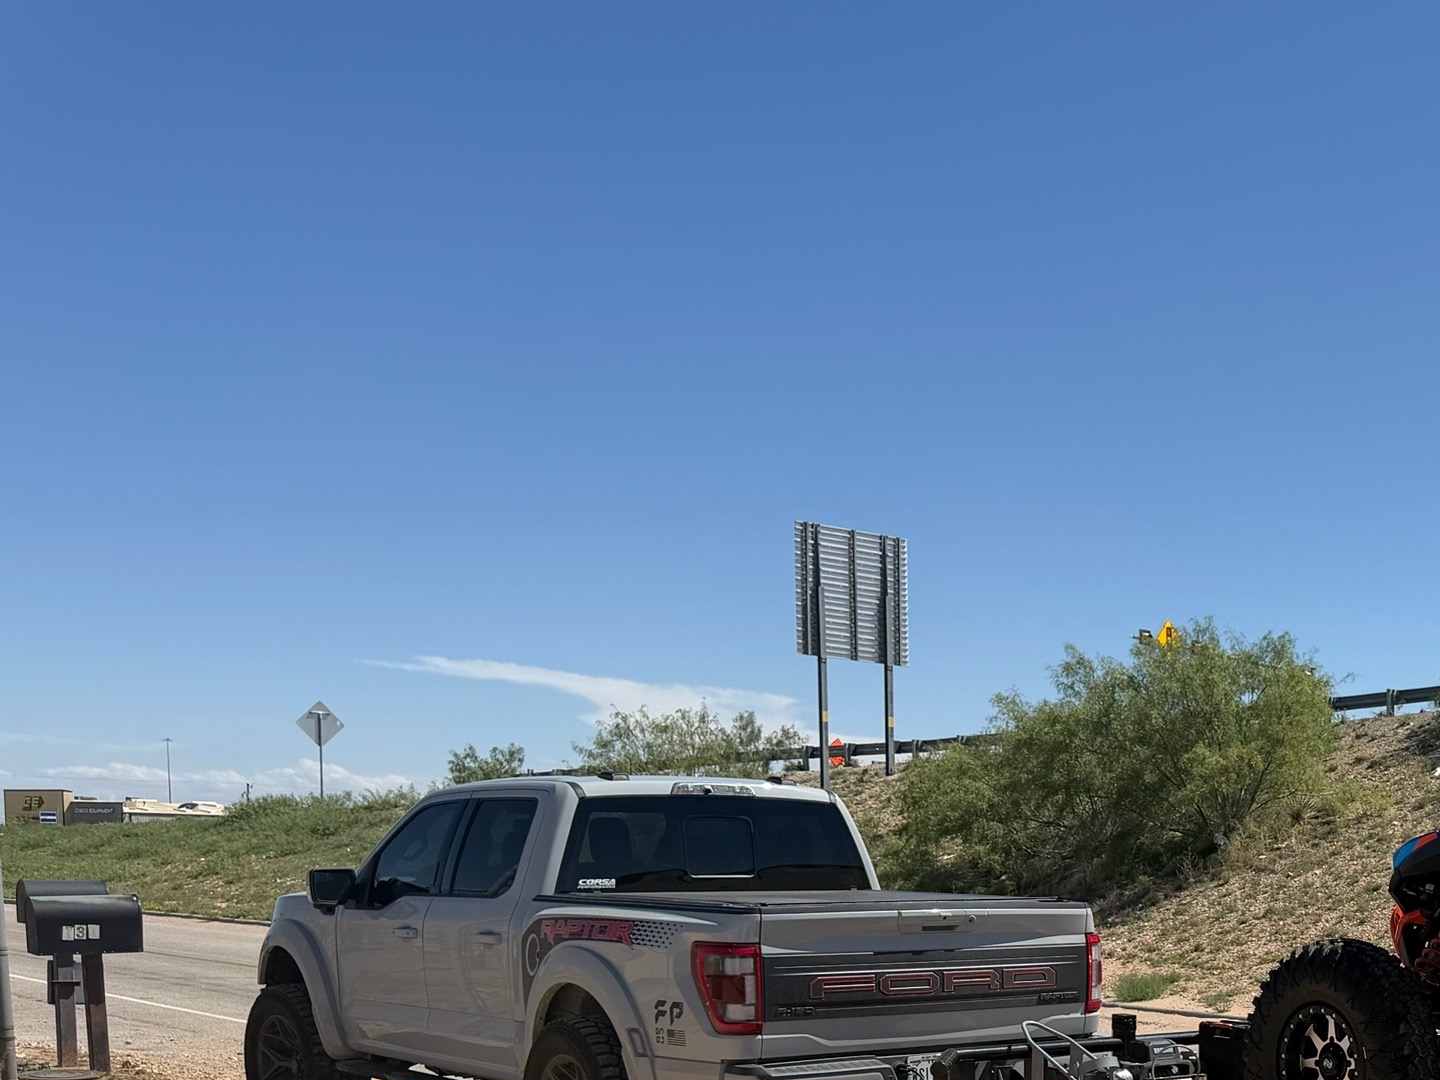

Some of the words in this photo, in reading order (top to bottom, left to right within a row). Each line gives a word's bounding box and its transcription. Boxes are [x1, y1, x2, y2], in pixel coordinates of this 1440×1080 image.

[578, 878, 616, 886] CORSA
[540, 919, 634, 950] RAPTOR
[809, 966, 1057, 1000] FORD
